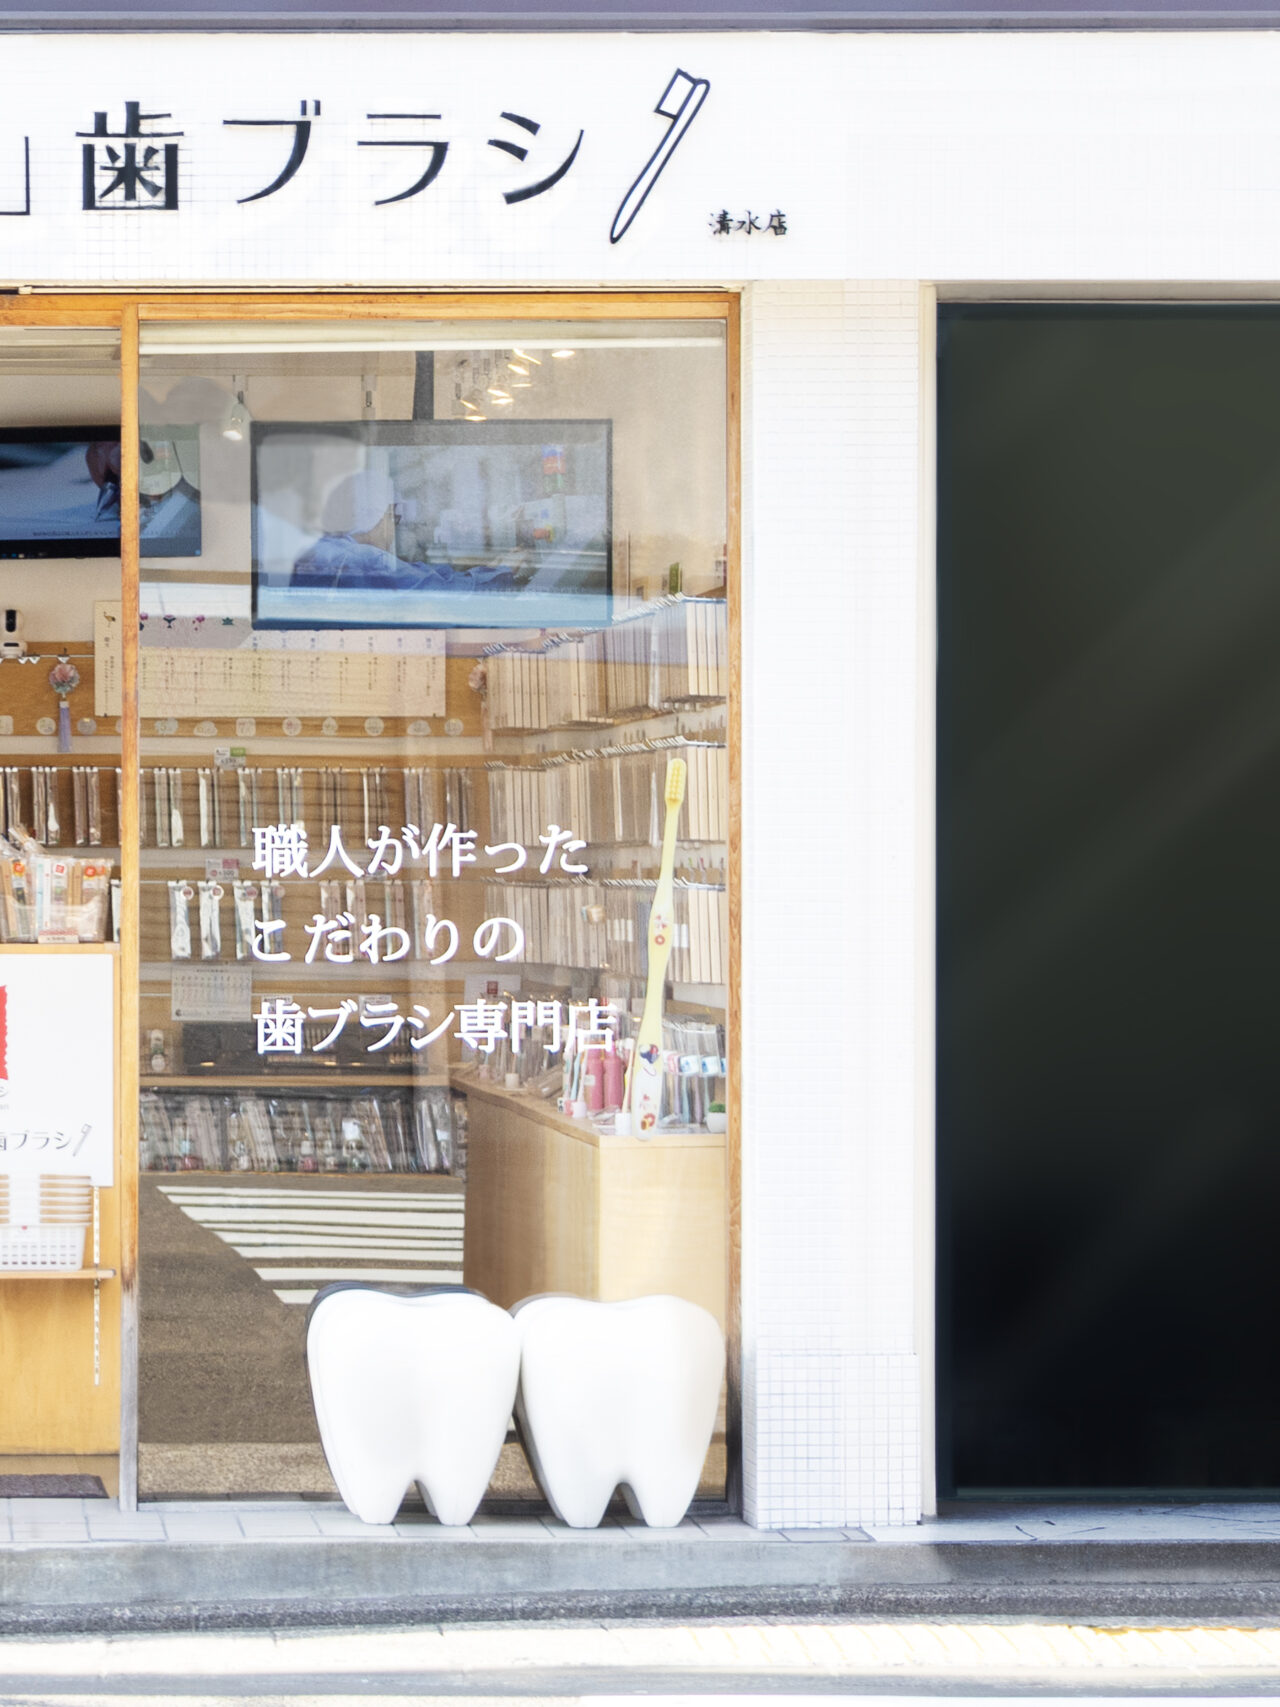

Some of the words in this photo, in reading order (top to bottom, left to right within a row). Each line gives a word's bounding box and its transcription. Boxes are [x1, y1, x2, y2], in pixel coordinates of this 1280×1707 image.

[708, 208, 788, 236] 清水店
[251, 822, 589, 879] 職人が作った
[250, 911, 526, 966] こだわりの
[252, 997, 619, 1055] 歯ブラシ専門店
